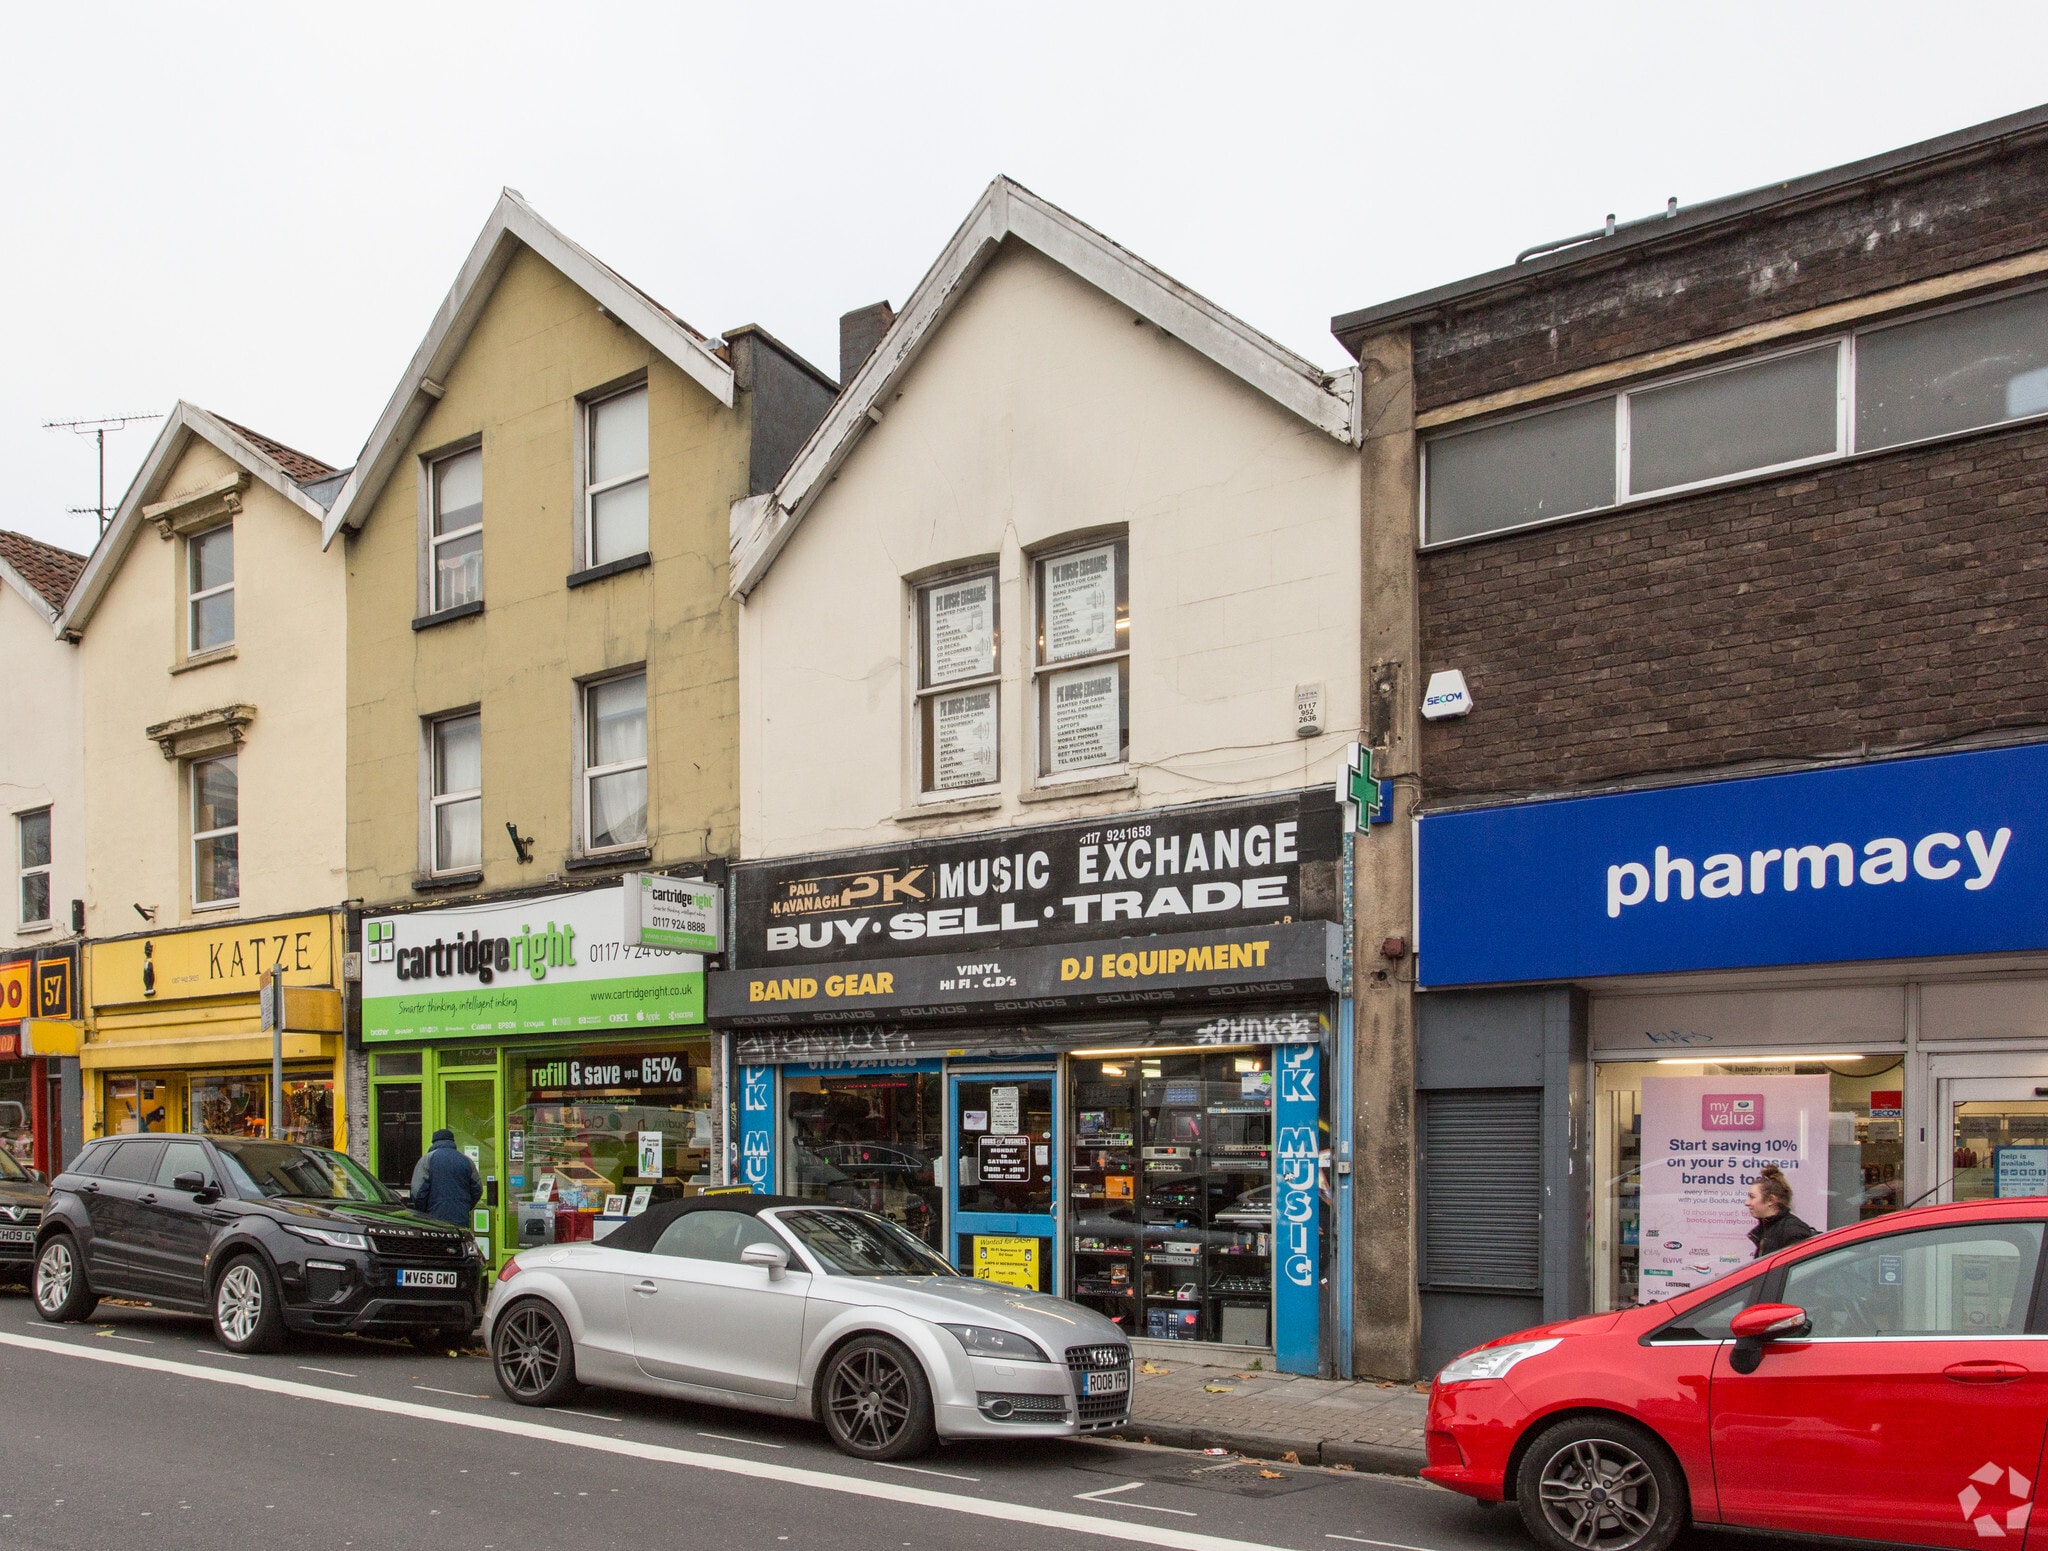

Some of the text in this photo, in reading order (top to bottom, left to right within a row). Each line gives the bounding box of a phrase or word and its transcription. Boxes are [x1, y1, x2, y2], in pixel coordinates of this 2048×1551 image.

[1298, 702, 1317, 710] 0117
[1427, 691, 1463, 706] SECOM
[1299, 714, 1317, 723] 2636
[1300, 708, 1314, 716] 952
[1106, 825, 1151, 842] 9241658
[938, 821, 1298, 900] MUSIC EXCHANGE
[1607, 827, 2012, 919] pharmacy
[789, 882, 820, 897] PAUL
[652, 889, 713, 910] cartridgeright
[772, 894, 840, 914] KAVANAGH
[767, 875, 1290, 952] BUY SELL TRADE
[652, 916, 706, 933] 0117 924 8888
[209, 931, 312, 980] KATZE
[396, 920, 577, 984] cartridgeright
[590, 943, 619, 963] 0117
[957, 963, 1002, 976] VINYL
[1061, 940, 1270, 982] DJ EQUIPMENT
[44, 975, 62, 1006] 57
[590, 983, 693, 1001] www.cartridgeright.co.uk
[750, 972, 894, 1002] BAND GEAR
[940, 980, 955, 990] HI
[958, 979, 971, 989] FI
[397, 1000, 425, 1015] Smarter
[458, 995, 495, 1015] intelligent
[494, 992, 518, 1013] inking
[731, 981, 1295, 1026] SOUNDS SOUNDS SOUNDS SOUNDS SOUNDS SOUNDS
[498, 1021, 517, 1030] EPSON
[609, 1013, 629, 1023] OKI
[532, 1056, 682, 1087] refill & save 65%
[1735, 1064, 1790, 1073] healthy weight
[1710, 1102, 1729, 1113] my
[1871, 1109, 1901, 1117] SECOM
[1710, 1111, 1755, 1126] value
[1669, 1138, 1798, 1154] Start saving 10%
[1667, 1156, 1799, 1170] on your 5 chosen
[2000, 1153, 2018, 1161] help
[983, 1165, 1001, 1173] 9am
[1682, 1172, 1734, 1185] brands
[1277, 1127, 1319, 1287] MUSIC
[368, 1227, 460, 1239] RANGE ROVER
[980, 1238, 1003, 1246] Wanted
[404, 1271, 434, 1284] WV66
[1114, 1372, 1127, 1390] YFR
